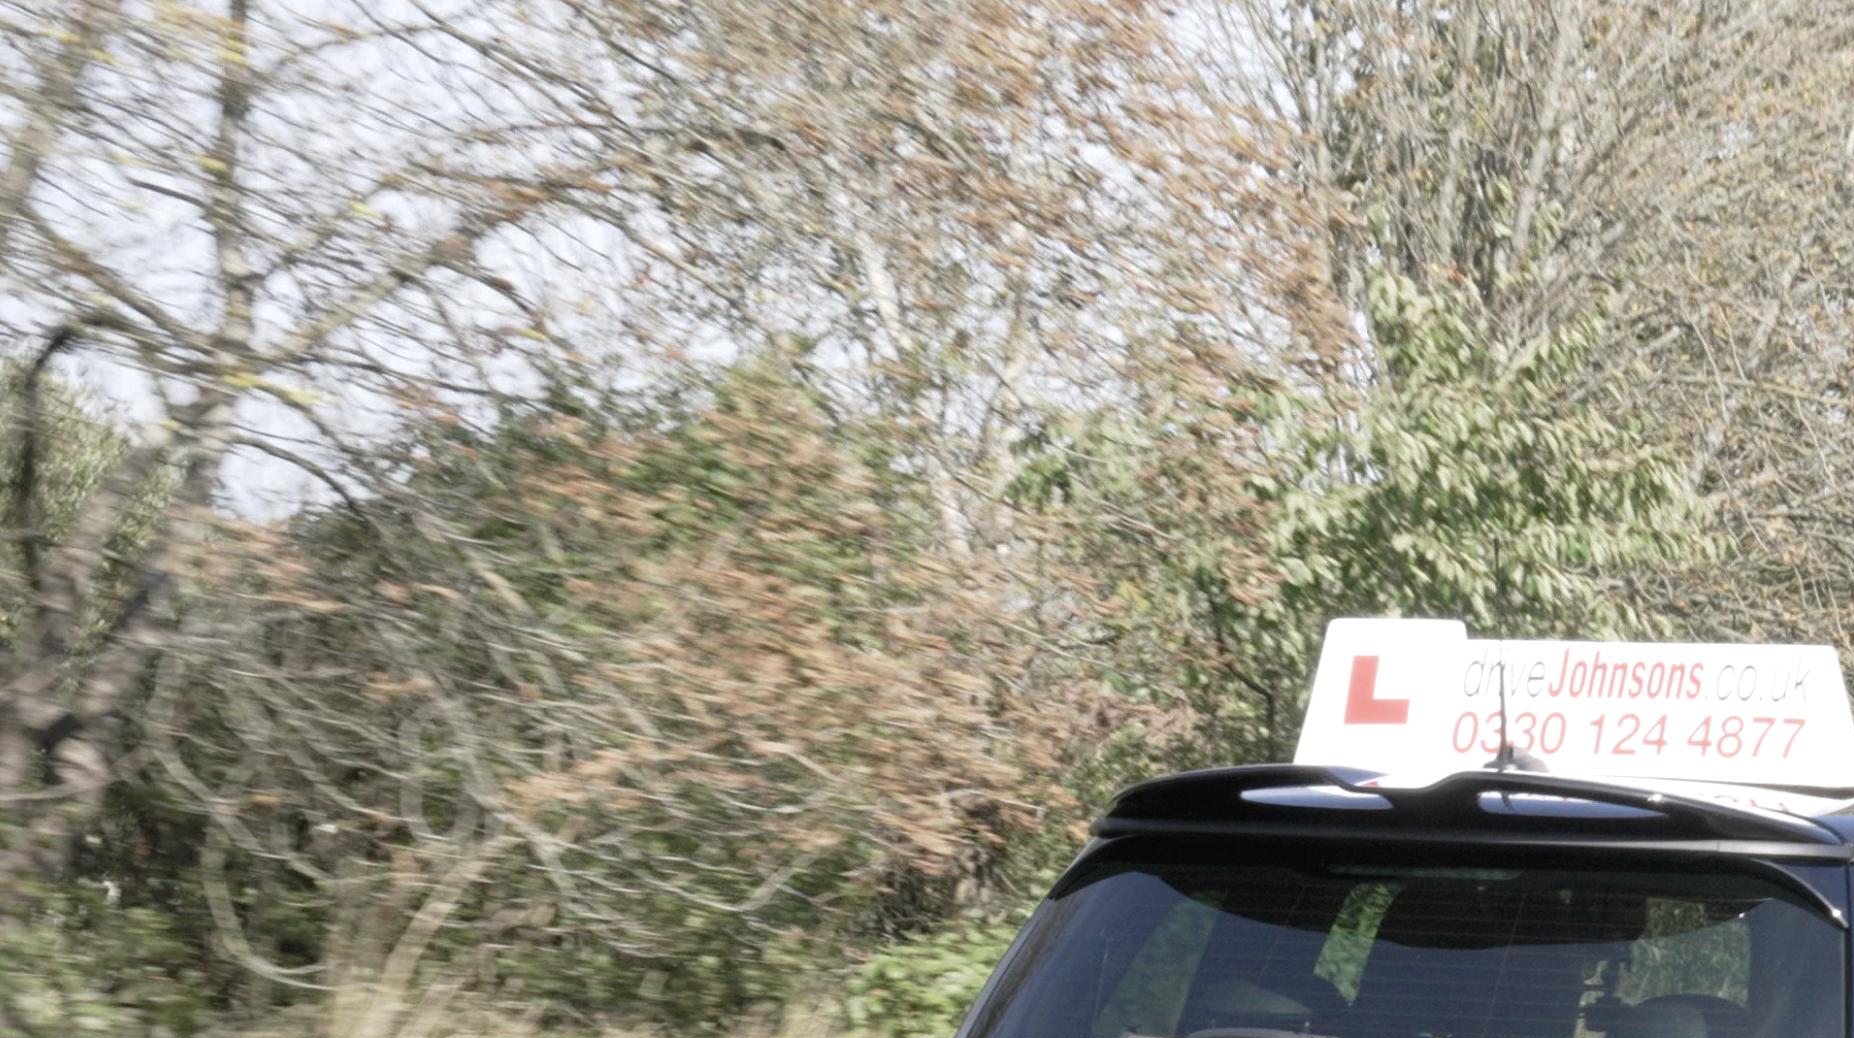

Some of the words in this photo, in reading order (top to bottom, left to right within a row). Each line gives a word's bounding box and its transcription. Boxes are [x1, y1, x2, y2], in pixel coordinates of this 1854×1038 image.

[1344, 655, 1411, 725] L
[1452, 711, 1567, 755] 0330
[1589, 713, 1668, 756] 124
[1687, 715, 1807, 758] 4877
